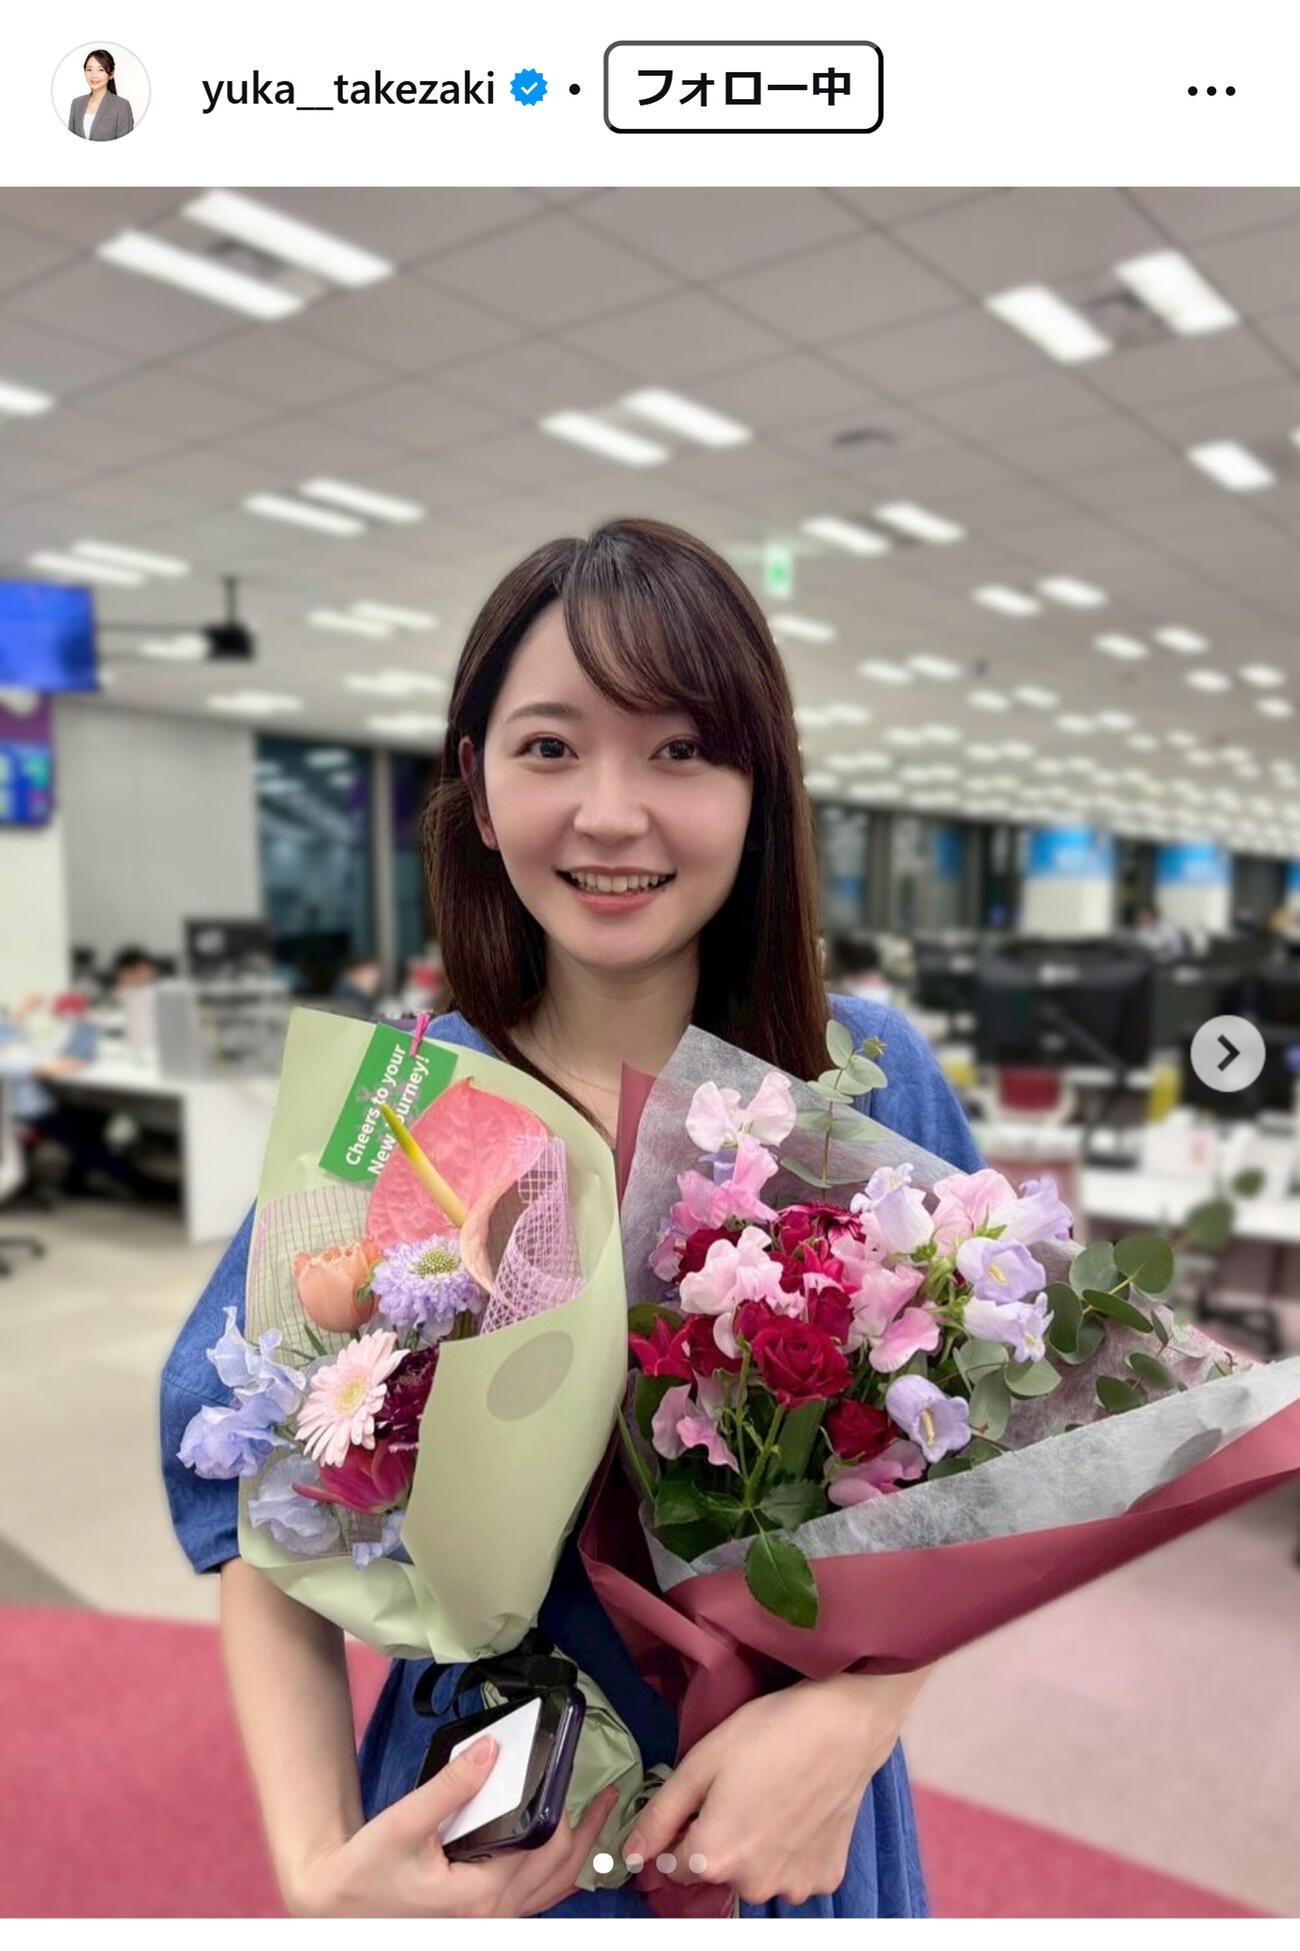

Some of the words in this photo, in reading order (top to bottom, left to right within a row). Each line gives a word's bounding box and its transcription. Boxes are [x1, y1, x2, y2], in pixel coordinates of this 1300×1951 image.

[346, 1107, 381, 1165] Cheers
[371, 1087, 389, 1106] to
[381, 1044, 406, 1087] your
[368, 1133, 396, 1175] New
[385, 1054, 430, 1128] ourney!
